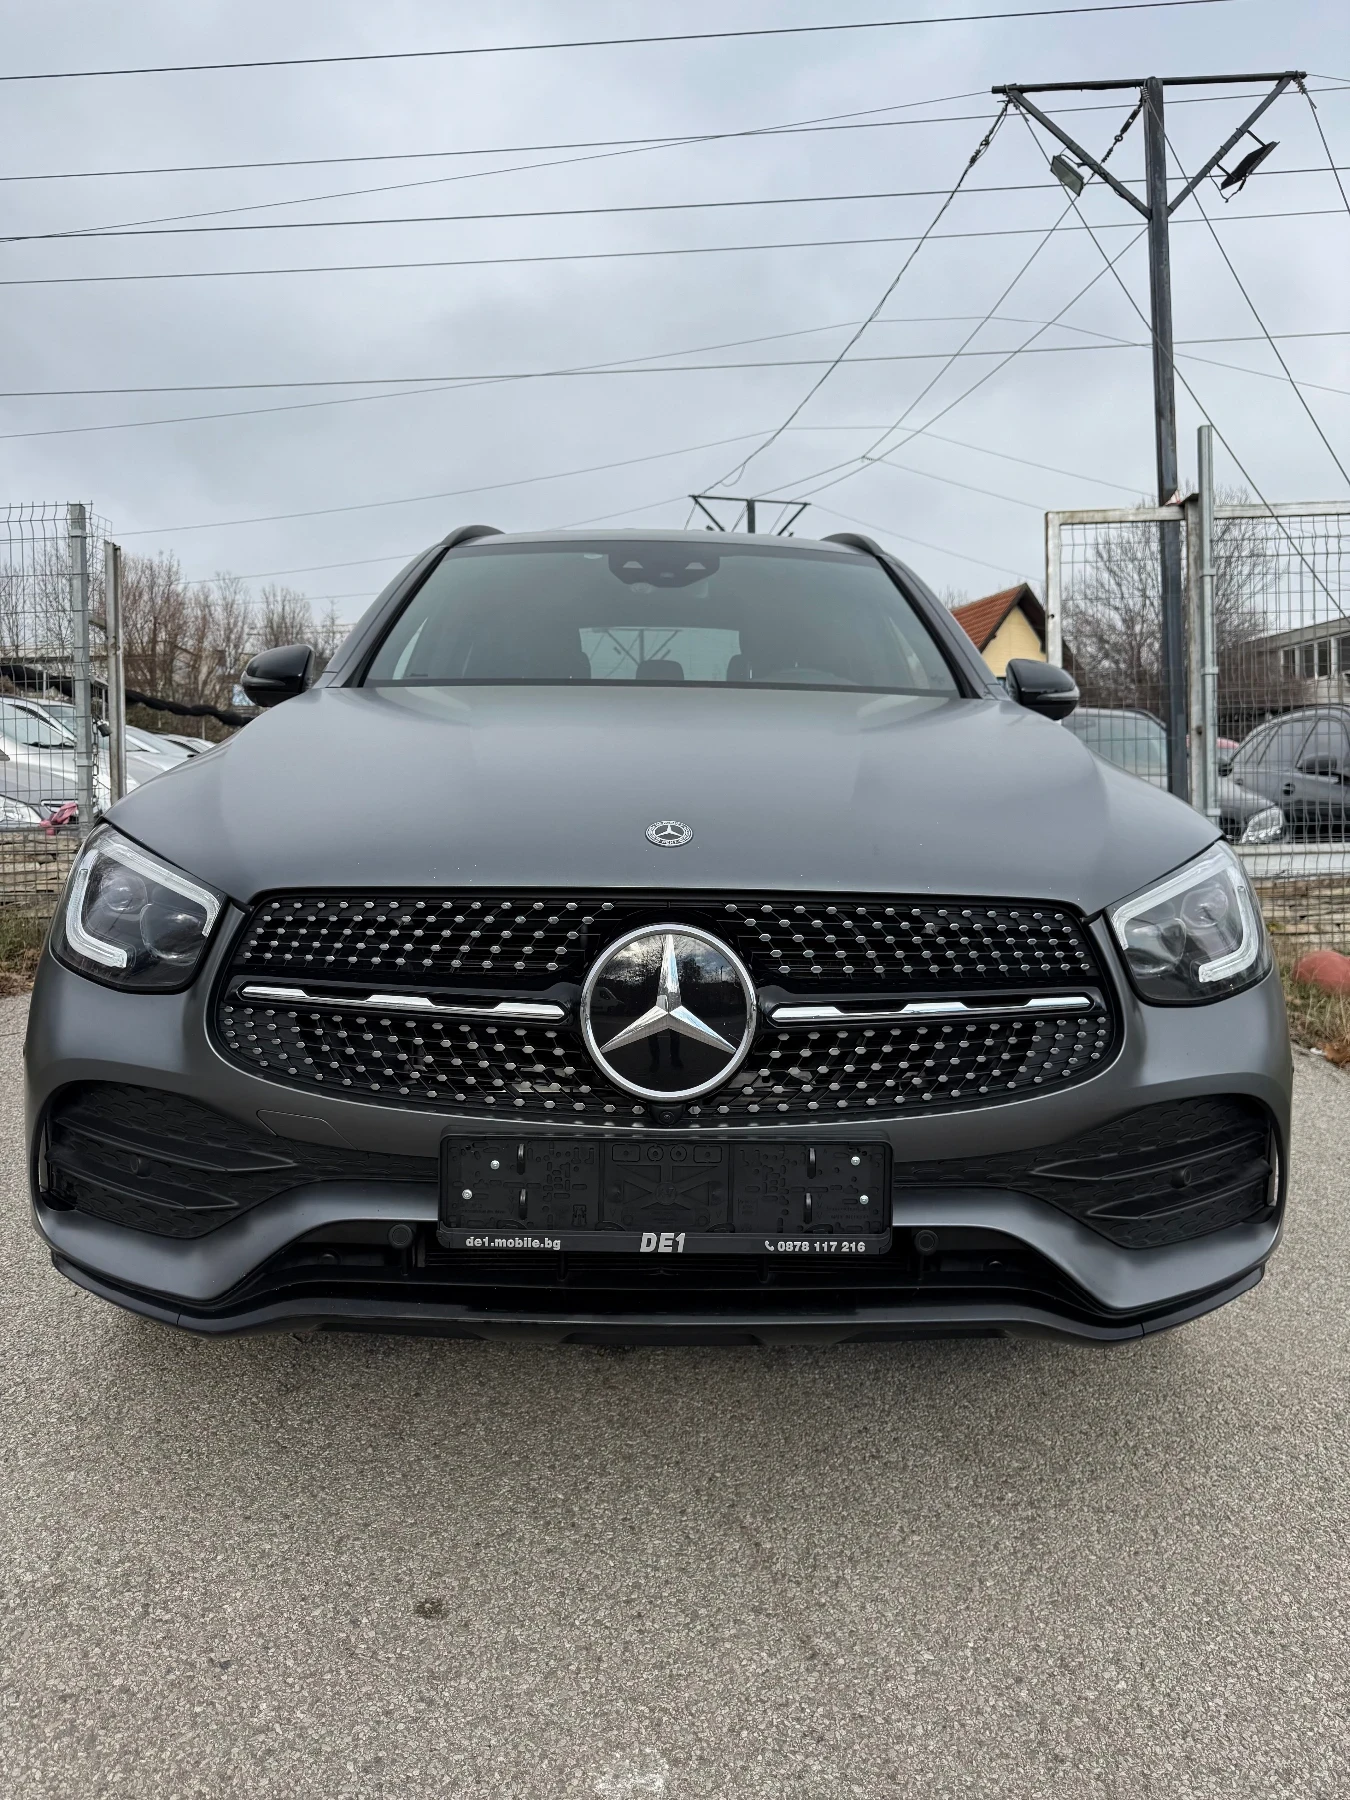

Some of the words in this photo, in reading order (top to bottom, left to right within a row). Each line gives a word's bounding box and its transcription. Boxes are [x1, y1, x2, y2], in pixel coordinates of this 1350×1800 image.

[465, 1236, 561, 1250] de1.mobile.bg
[639, 1232, 685, 1252] DE1
[777, 1241, 810, 1252] 0878
[813, 1241, 838, 1252] 117
[840, 1241, 866, 1252] 216
